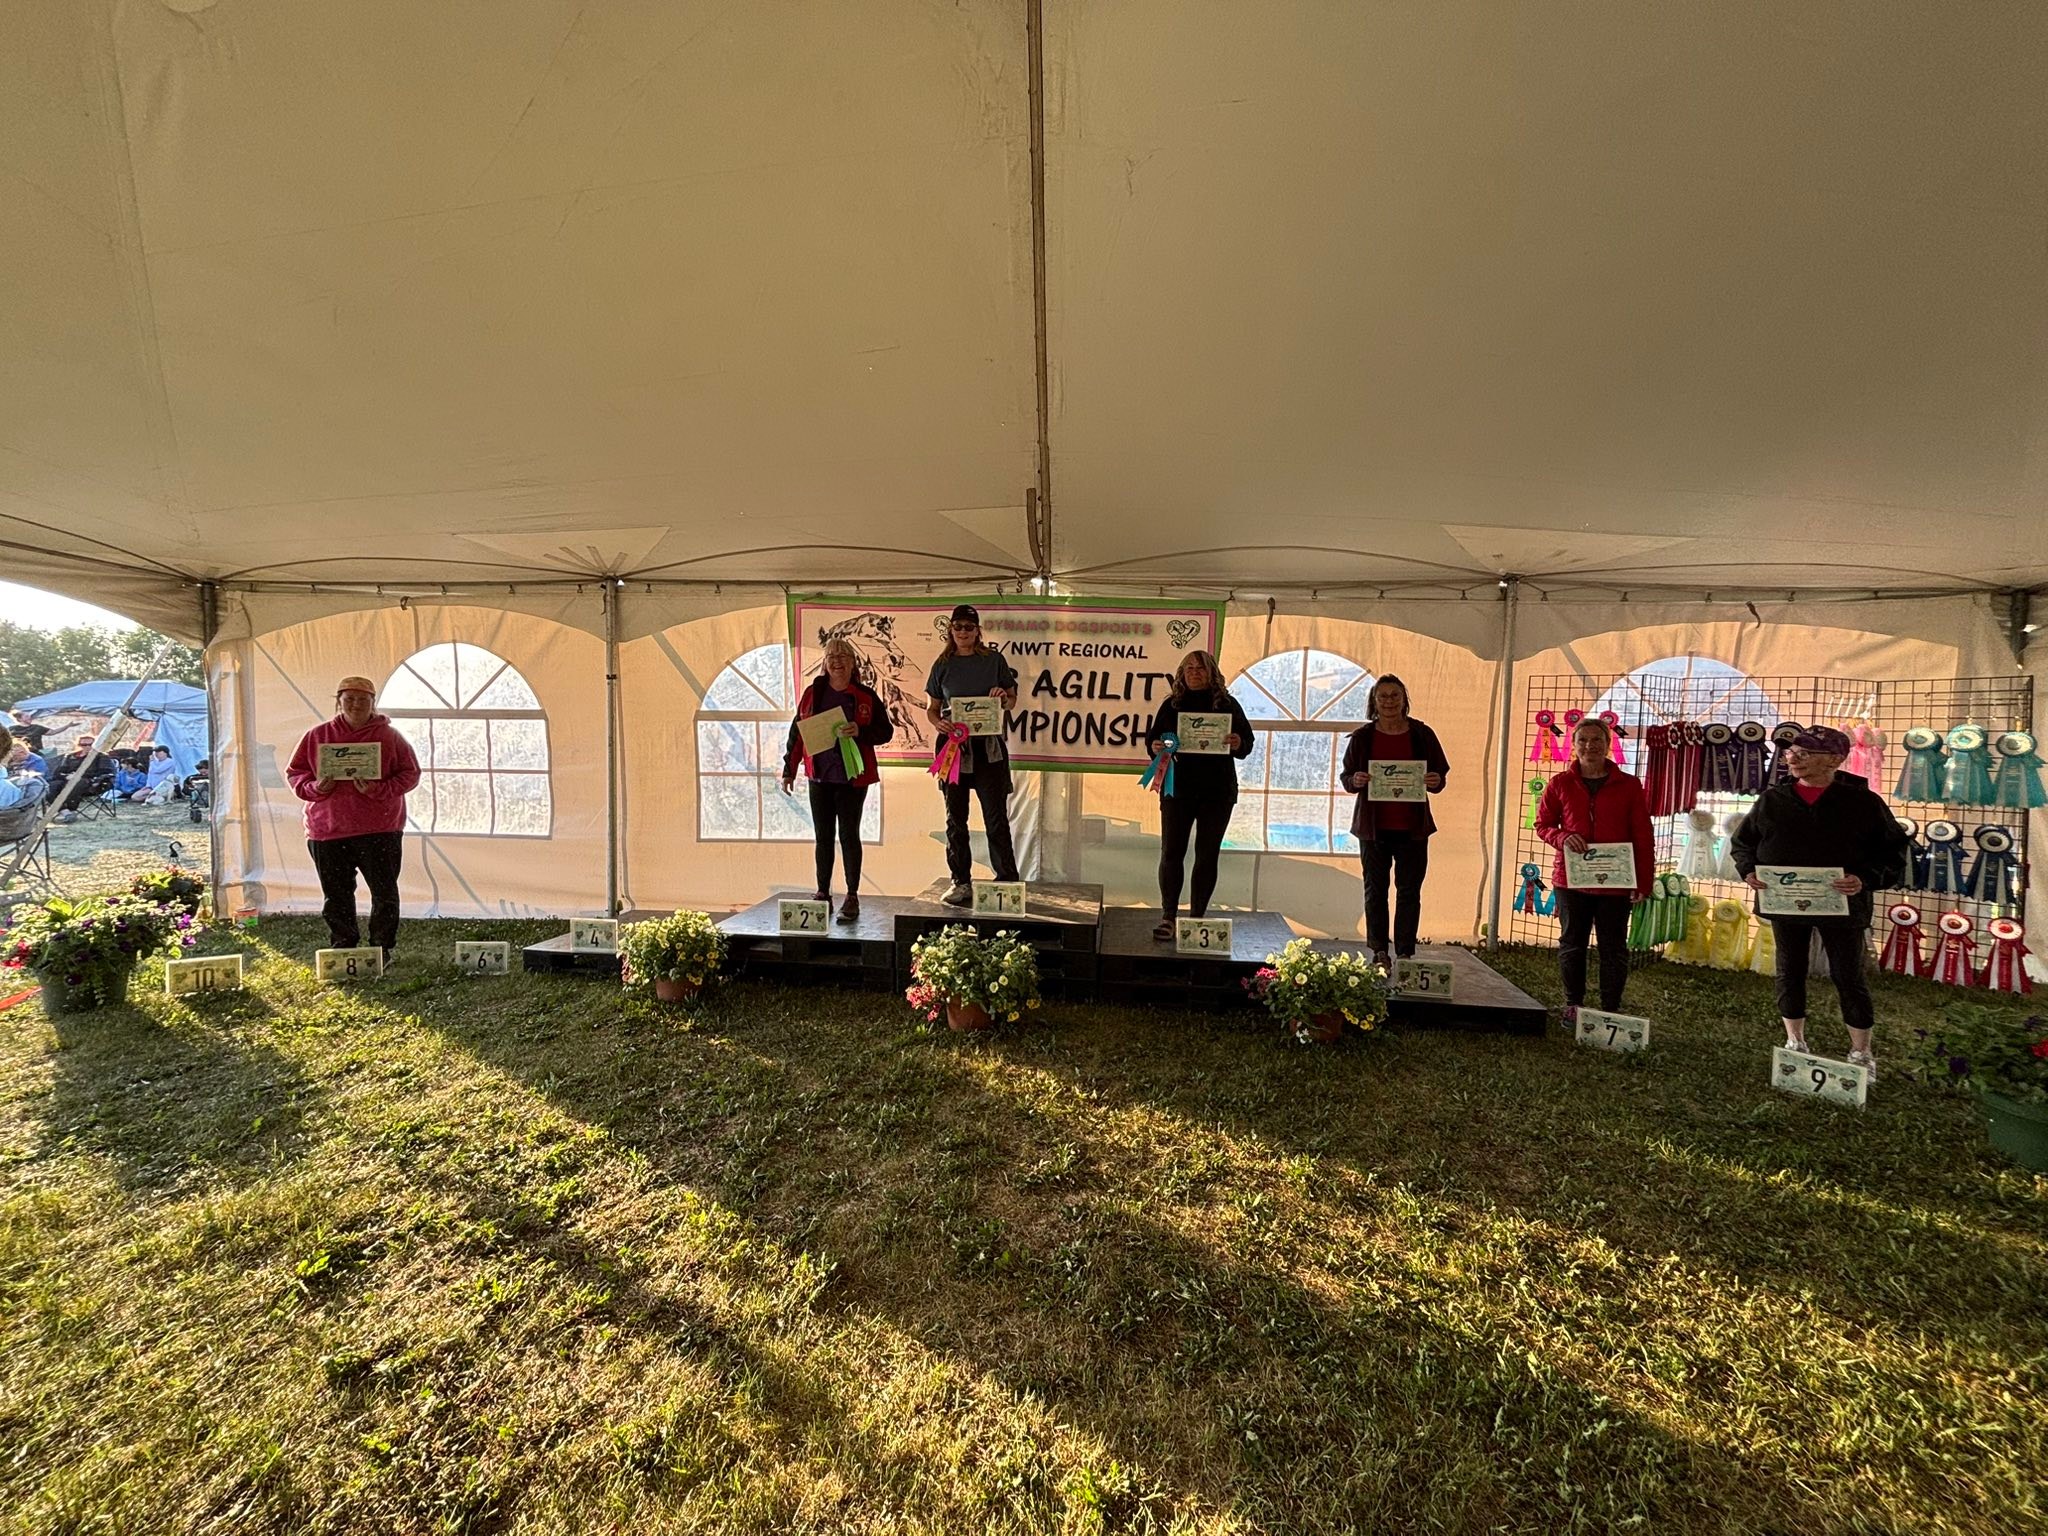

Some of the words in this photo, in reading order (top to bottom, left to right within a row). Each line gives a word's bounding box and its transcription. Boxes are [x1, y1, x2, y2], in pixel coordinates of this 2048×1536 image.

[983, 619, 1050, 631] DYNAMO
[1055, 620, 1153, 635] DOGSPORTS
[981, 641, 1055, 656] B/NWT
[1059, 642, 1148, 659] REGIONAL
[1002, 709, 1153, 747] MPIONSH
[800, 910, 809, 929] 2
[590, 929, 600, 948] 4
[1199, 928, 1209, 948] 3
[345, 957, 357, 976] 8
[477, 951, 487, 969] 6
[191, 967, 215, 989] 10
[1419, 970, 1430, 991] 5
[1605, 1024, 1617, 1046] 7
[1811, 1068, 1827, 1093] 9
